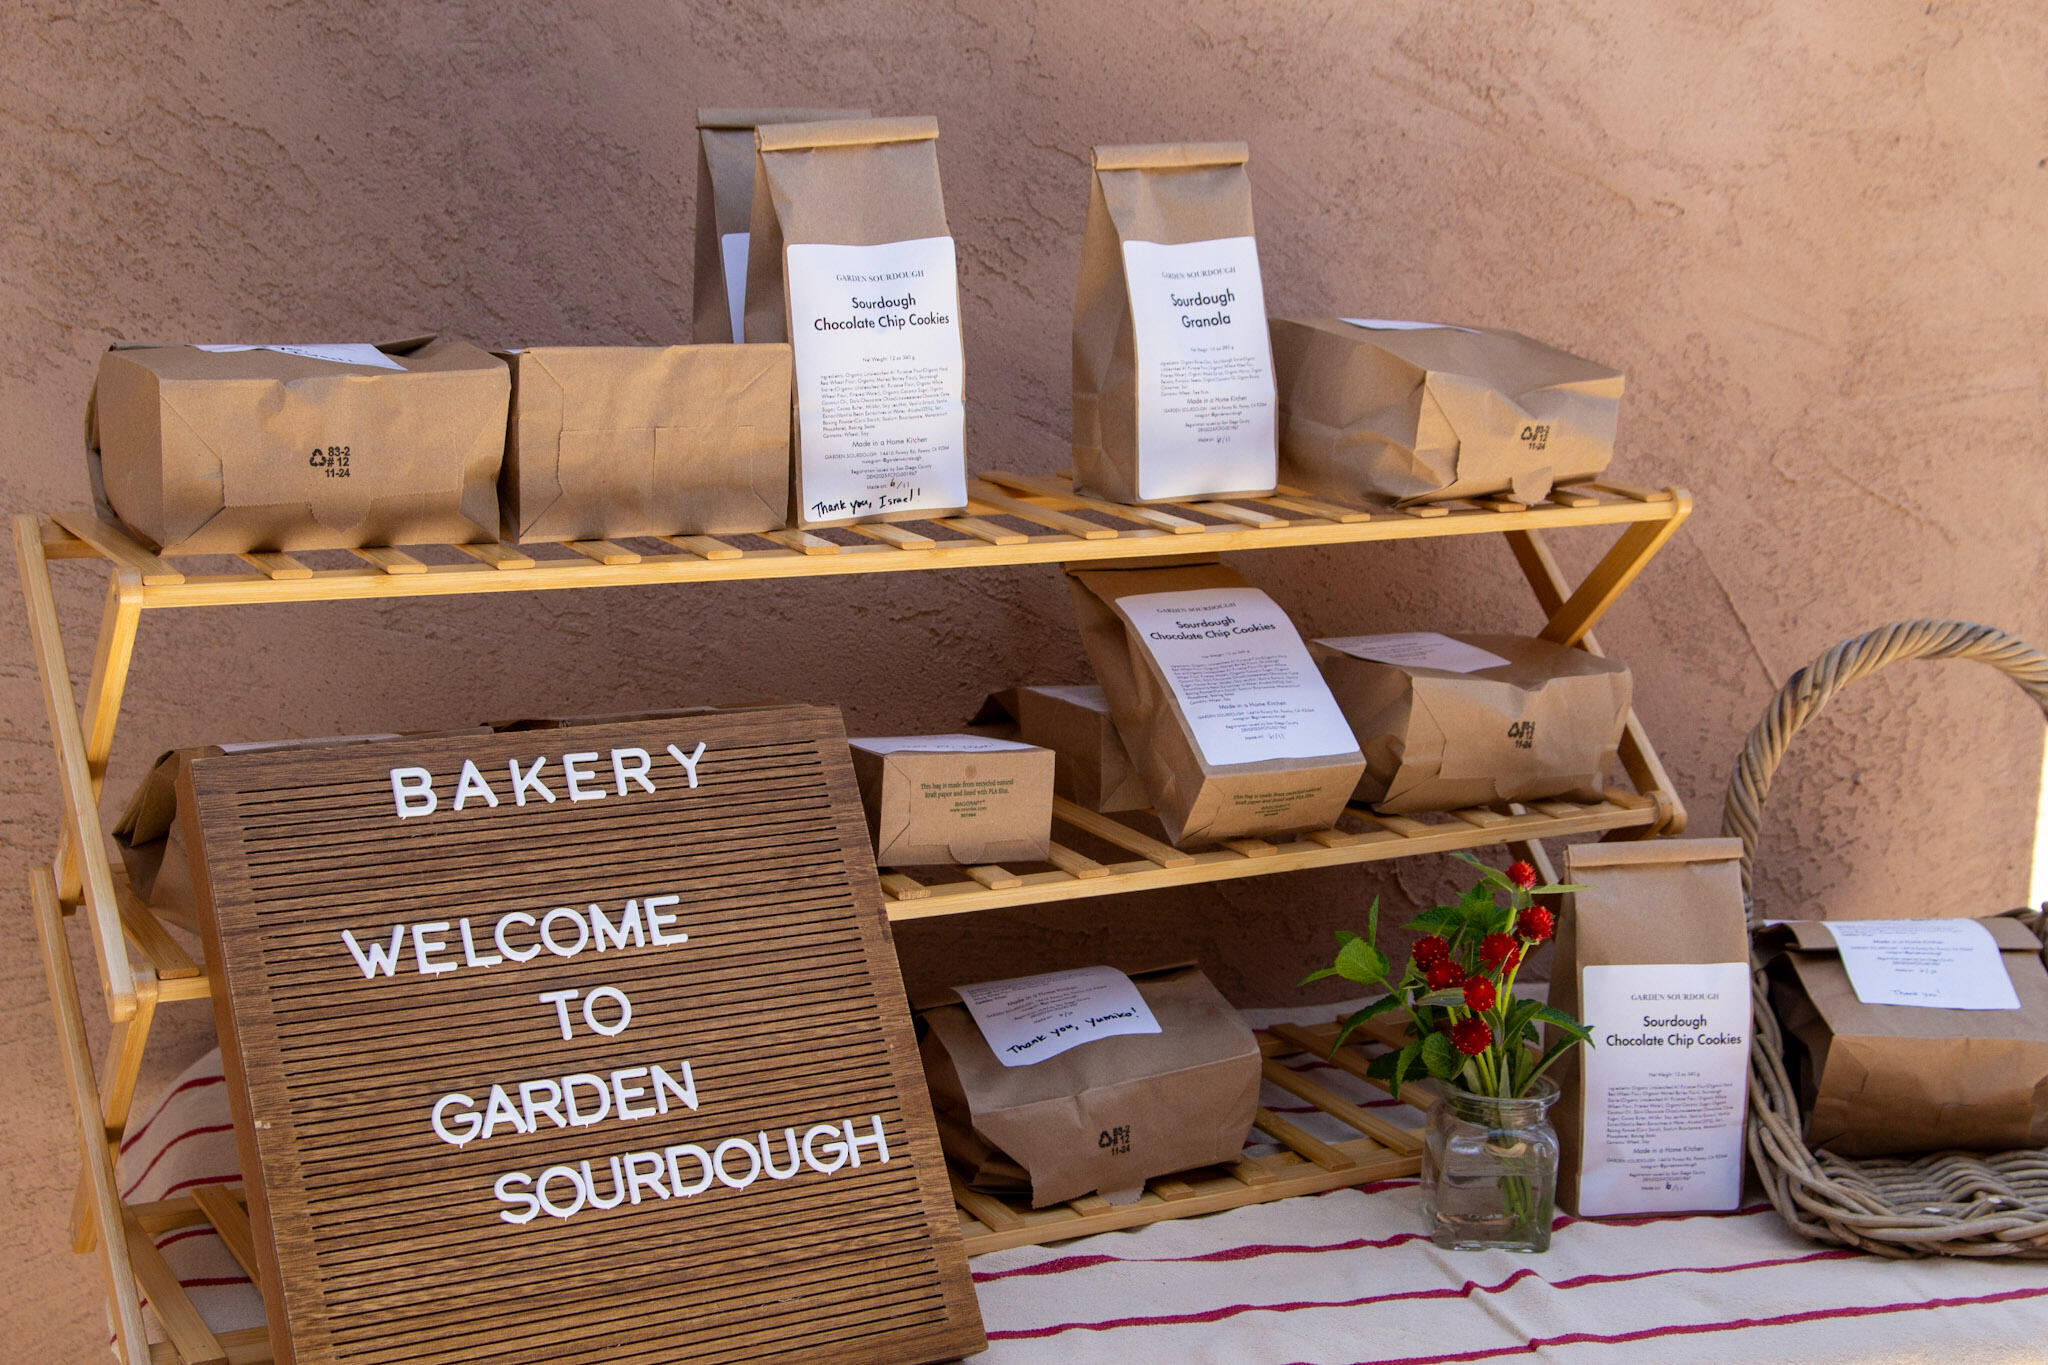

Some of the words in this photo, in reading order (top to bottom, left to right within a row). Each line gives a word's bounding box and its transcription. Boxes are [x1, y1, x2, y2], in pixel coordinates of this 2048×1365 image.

[836, 274, 867, 282] GARDEN
[869, 270, 925, 282] SOURDOUGH
[852, 293, 916, 310] Sourdough
[1171, 288, 1235, 307] Sourdough
[814, 316, 876, 331] Chocolate
[878, 315, 906, 330] Chip
[909, 312, 950, 326] Cookies
[1181, 311, 1231, 328] Granola
[328, 446, 350, 457] 83-2
[327, 457, 334, 467] #
[337, 457, 349, 467] 12
[325, 468, 350, 478] 11-24
[812, 500, 846, 518] Thank
[850, 499, 872, 514] you,
[1176, 616, 1235, 629] Sourdough
[1150, 629, 1203, 641] Chocolate
[1205, 628, 1231, 640] Chip
[1232, 622, 1276, 635] Cookies
[390, 742, 706, 819] BAKERY
[948, 781, 962, 789] made
[938, 790, 952, 799] paper
[341, 894, 689, 979] WELCOME
[1630, 993, 1665, 1001] GARDEN
[1666, 993, 1720, 1001] SOURDOUGH
[539, 985, 632, 1041] TO
[1006, 1034, 1047, 1054] Thank
[1050, 1024, 1079, 1037] you,
[1085, 1007, 1139, 1027] Yumiko!
[1643, 1015, 1707, 1029] Sourdough
[1606, 1034, 1664, 1047] Chocolate
[1667, 1033, 1695, 1048] Chip
[1697, 1031, 1742, 1045] Cookies
[431, 1060, 699, 1148] GARDEN
[494, 1114, 891, 1225] SOURDOUGH
